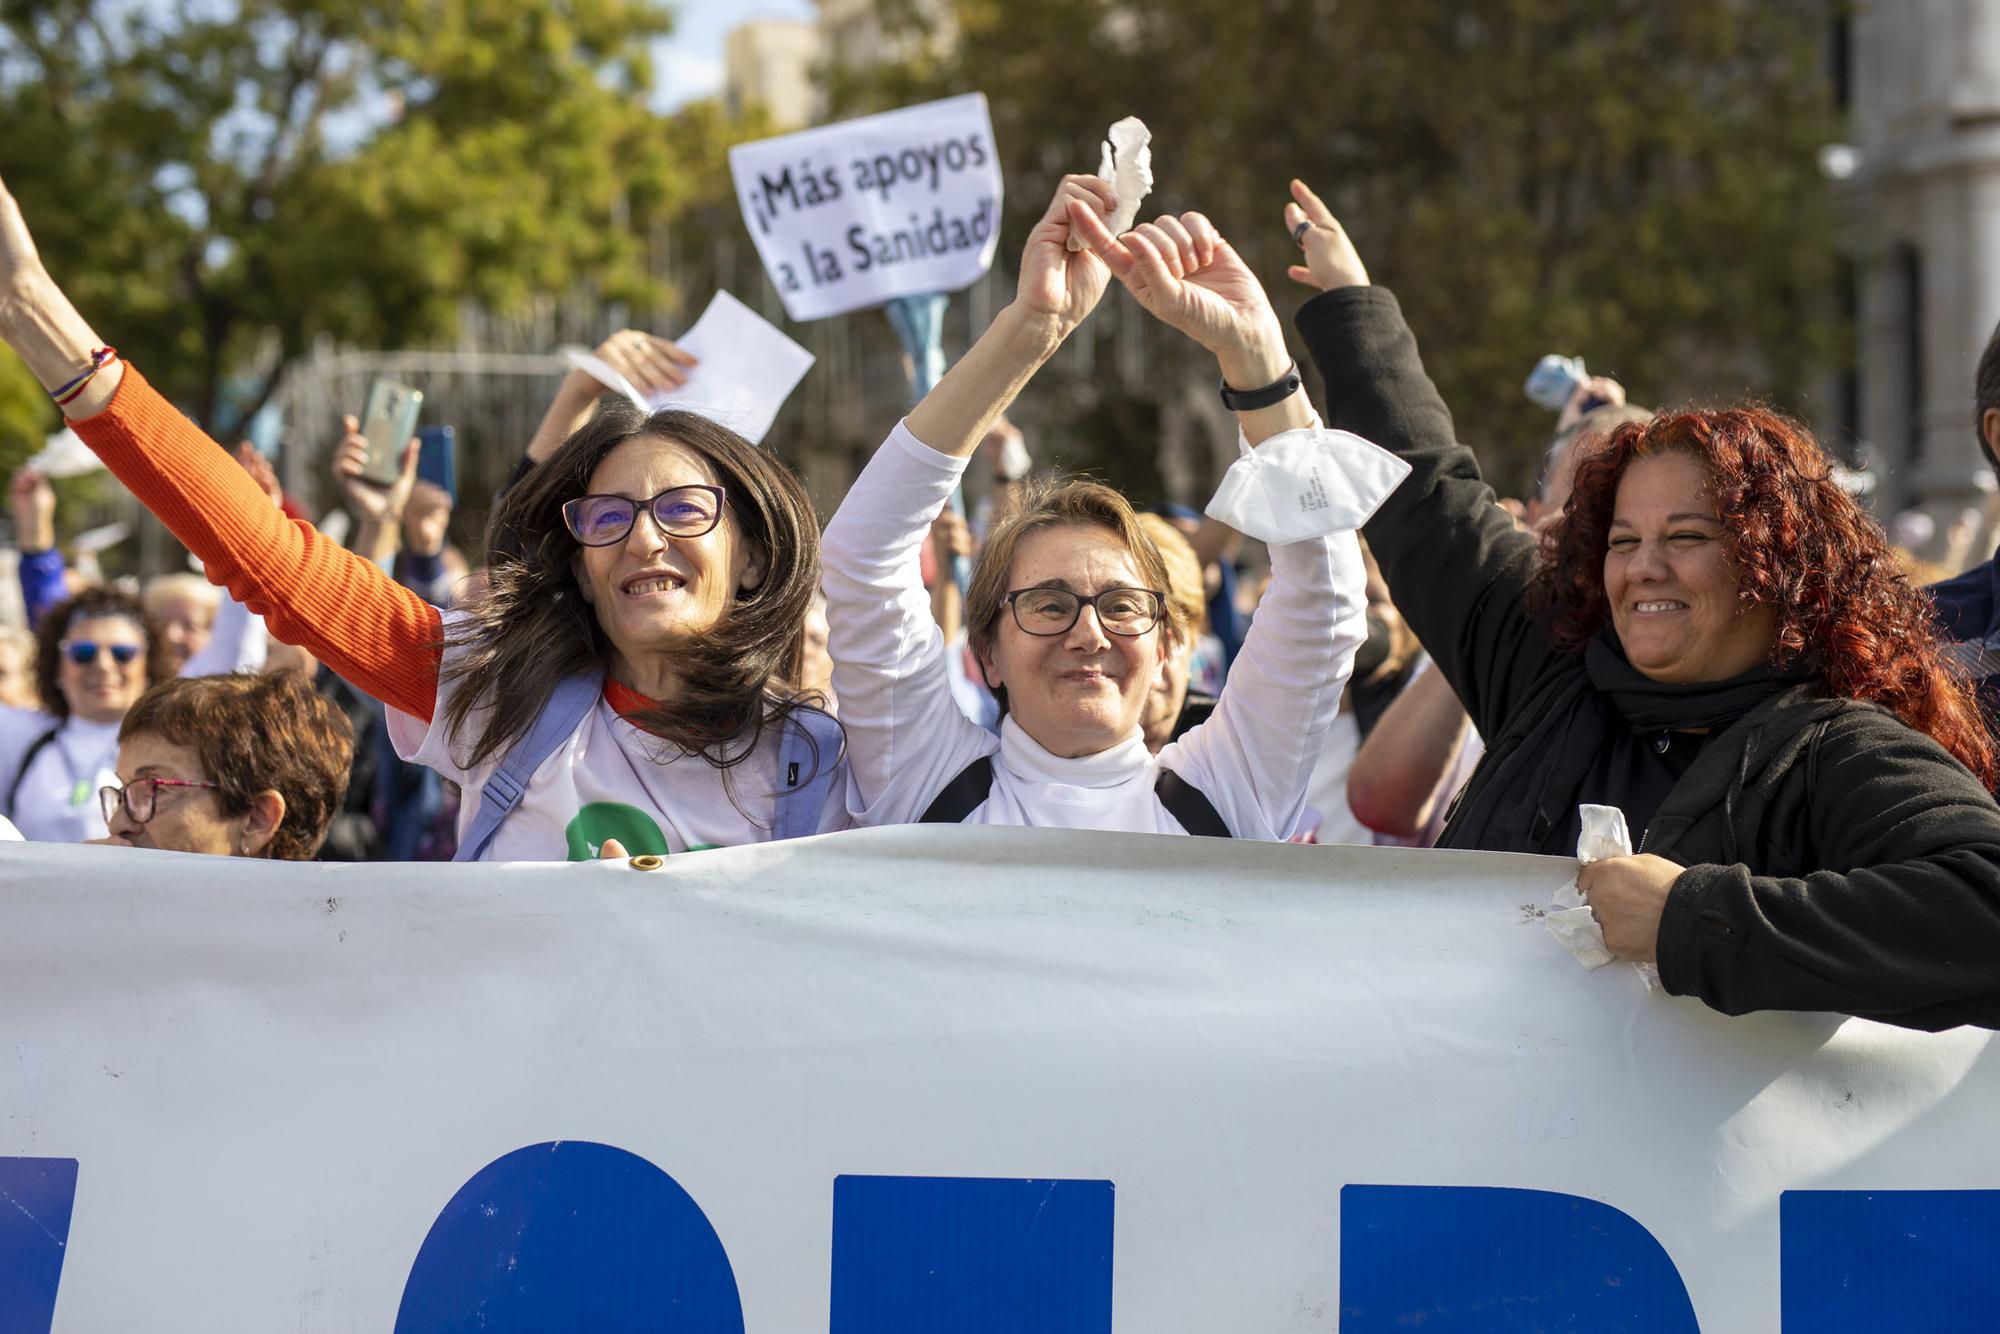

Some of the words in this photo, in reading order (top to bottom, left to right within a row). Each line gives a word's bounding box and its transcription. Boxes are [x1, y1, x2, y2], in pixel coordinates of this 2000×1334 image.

[751, 159, 841, 234] ¡Más
[852, 134, 986, 201] apoyos
[779, 262, 800, 291] a
[803, 240, 842, 284] la
